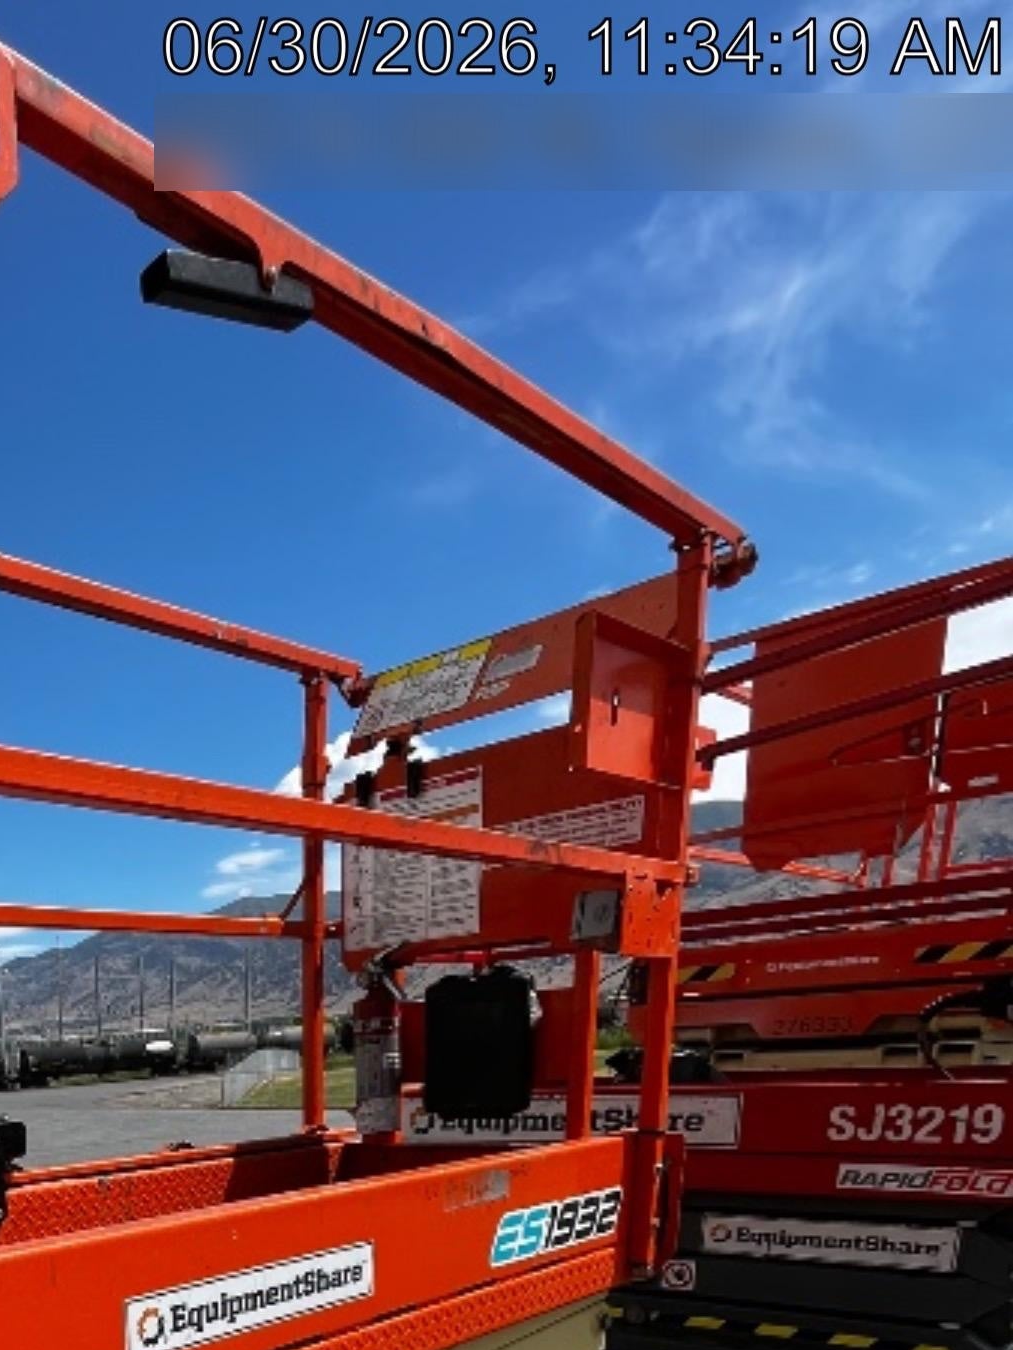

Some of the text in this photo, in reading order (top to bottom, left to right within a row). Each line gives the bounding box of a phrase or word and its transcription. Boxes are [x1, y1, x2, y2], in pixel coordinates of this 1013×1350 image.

[827, 1103, 1005, 1144] SJ3219
[492, 1190, 622, 1262] ES1932
[736, 1225, 940, 1257] EquipmentShare
[170, 1264, 364, 1334] EquipmentShare
